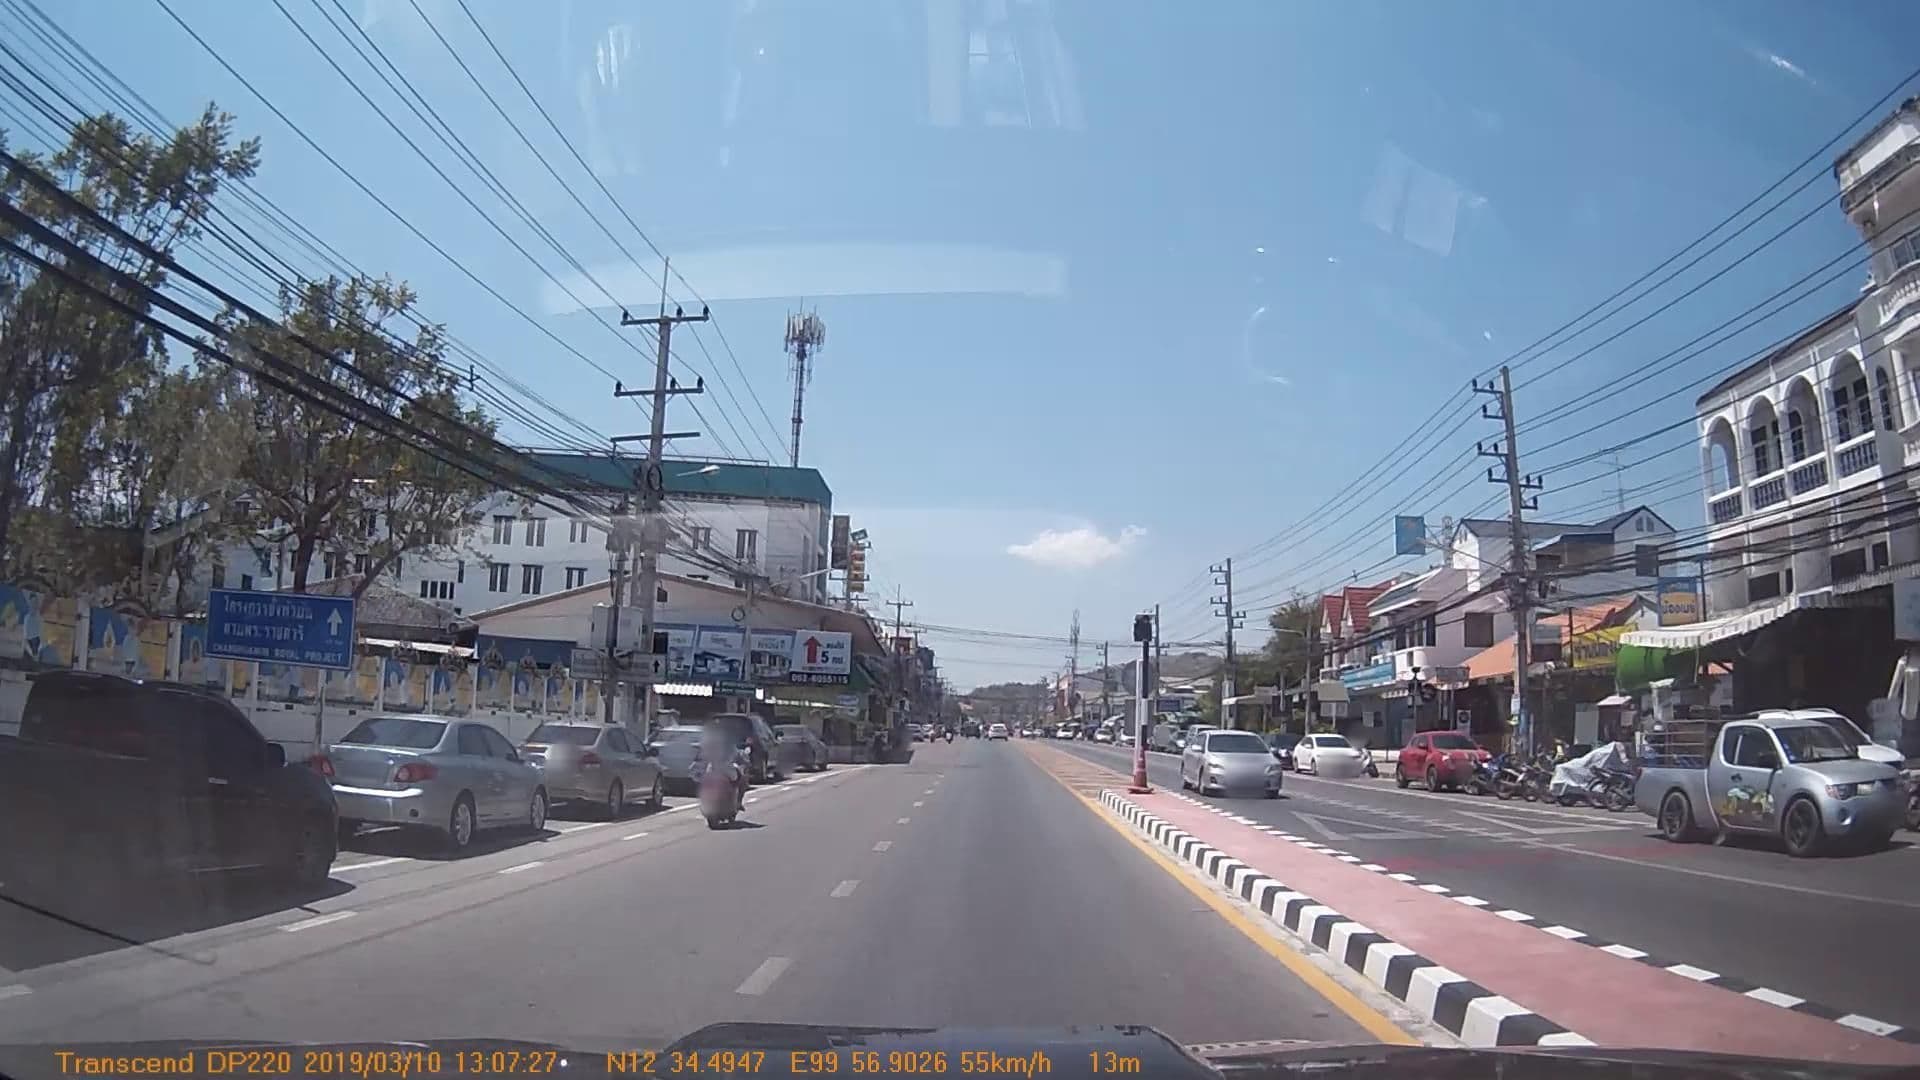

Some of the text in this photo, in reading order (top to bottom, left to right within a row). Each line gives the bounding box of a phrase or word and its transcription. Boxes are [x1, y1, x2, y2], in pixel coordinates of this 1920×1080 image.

[274, 647, 300, 660] ROYAL
[304, 650, 343, 663] PROJECT
[821, 650, 830, 664] 5
